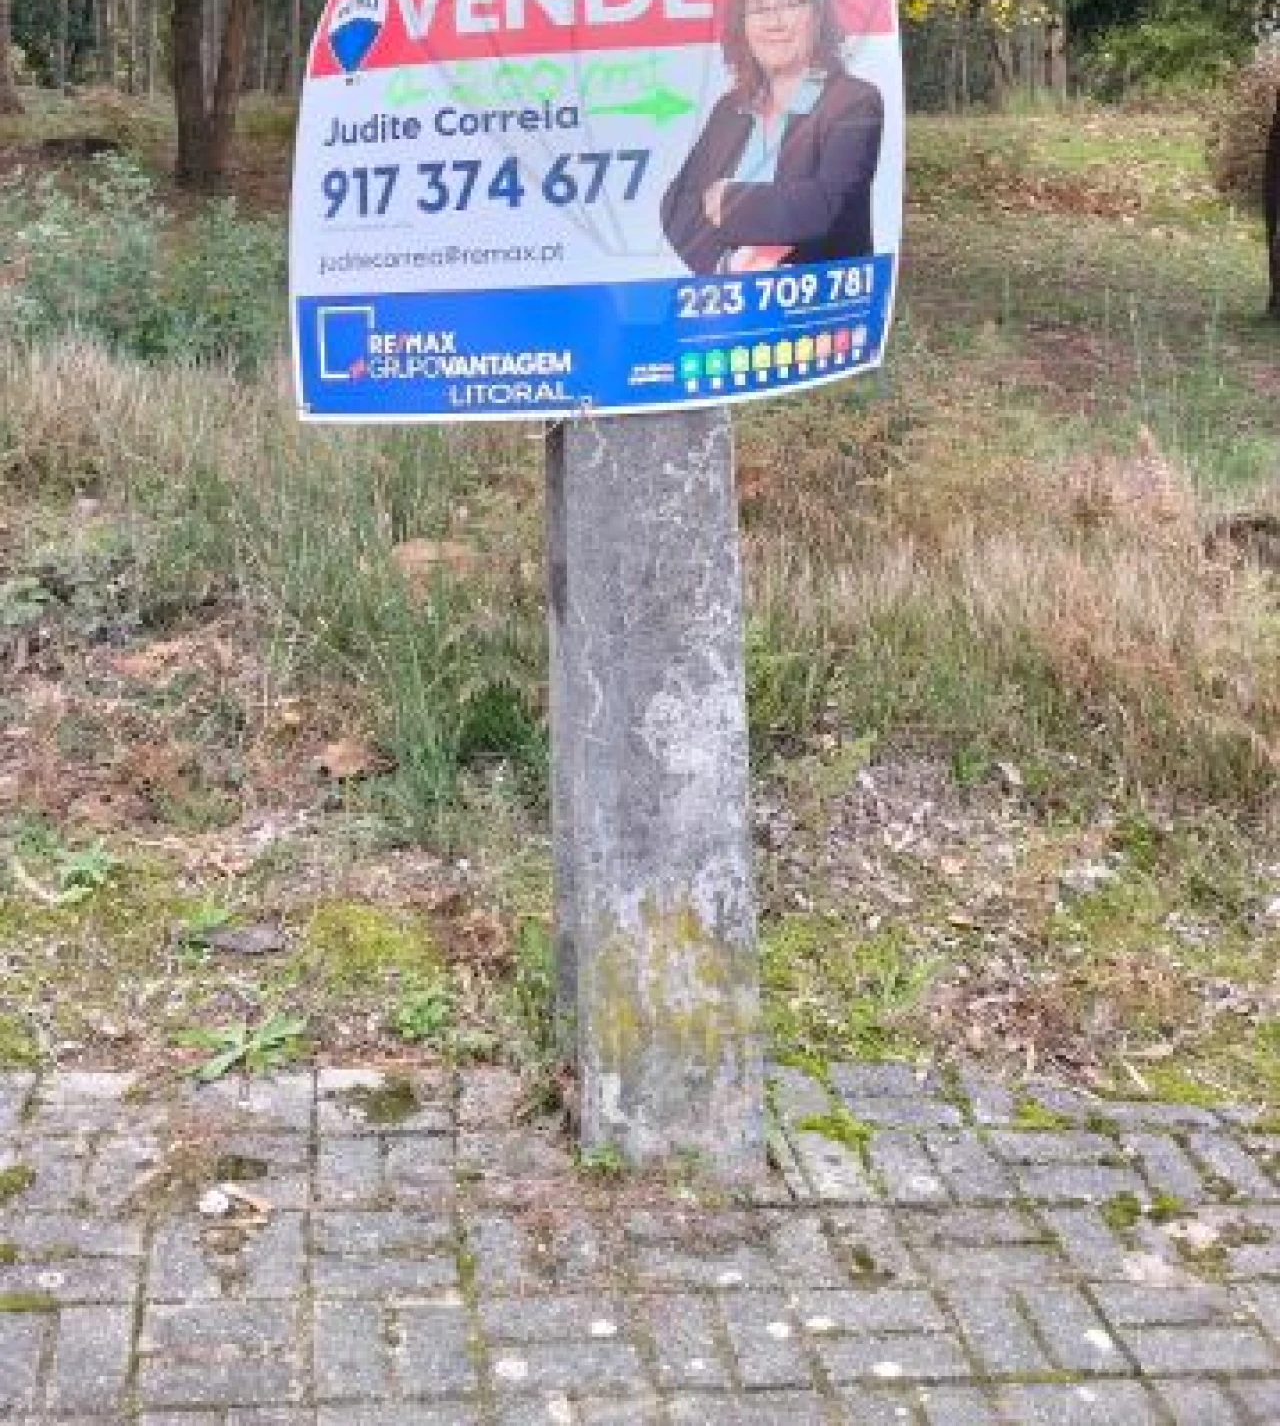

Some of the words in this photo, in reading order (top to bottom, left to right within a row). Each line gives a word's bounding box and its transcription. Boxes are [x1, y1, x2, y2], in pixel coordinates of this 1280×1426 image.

[323, 113, 422, 147] Judite
[433, 99, 580, 137] Correia
[321, 166, 402, 219] 917
[415, 153, 526, 215] 374
[540, 147, 652, 207] 677
[676, 280, 746, 319] 223
[755, 271, 818, 312] 709
[826, 262, 876, 302] 781
[452, 379, 576, 405] LITORAL
